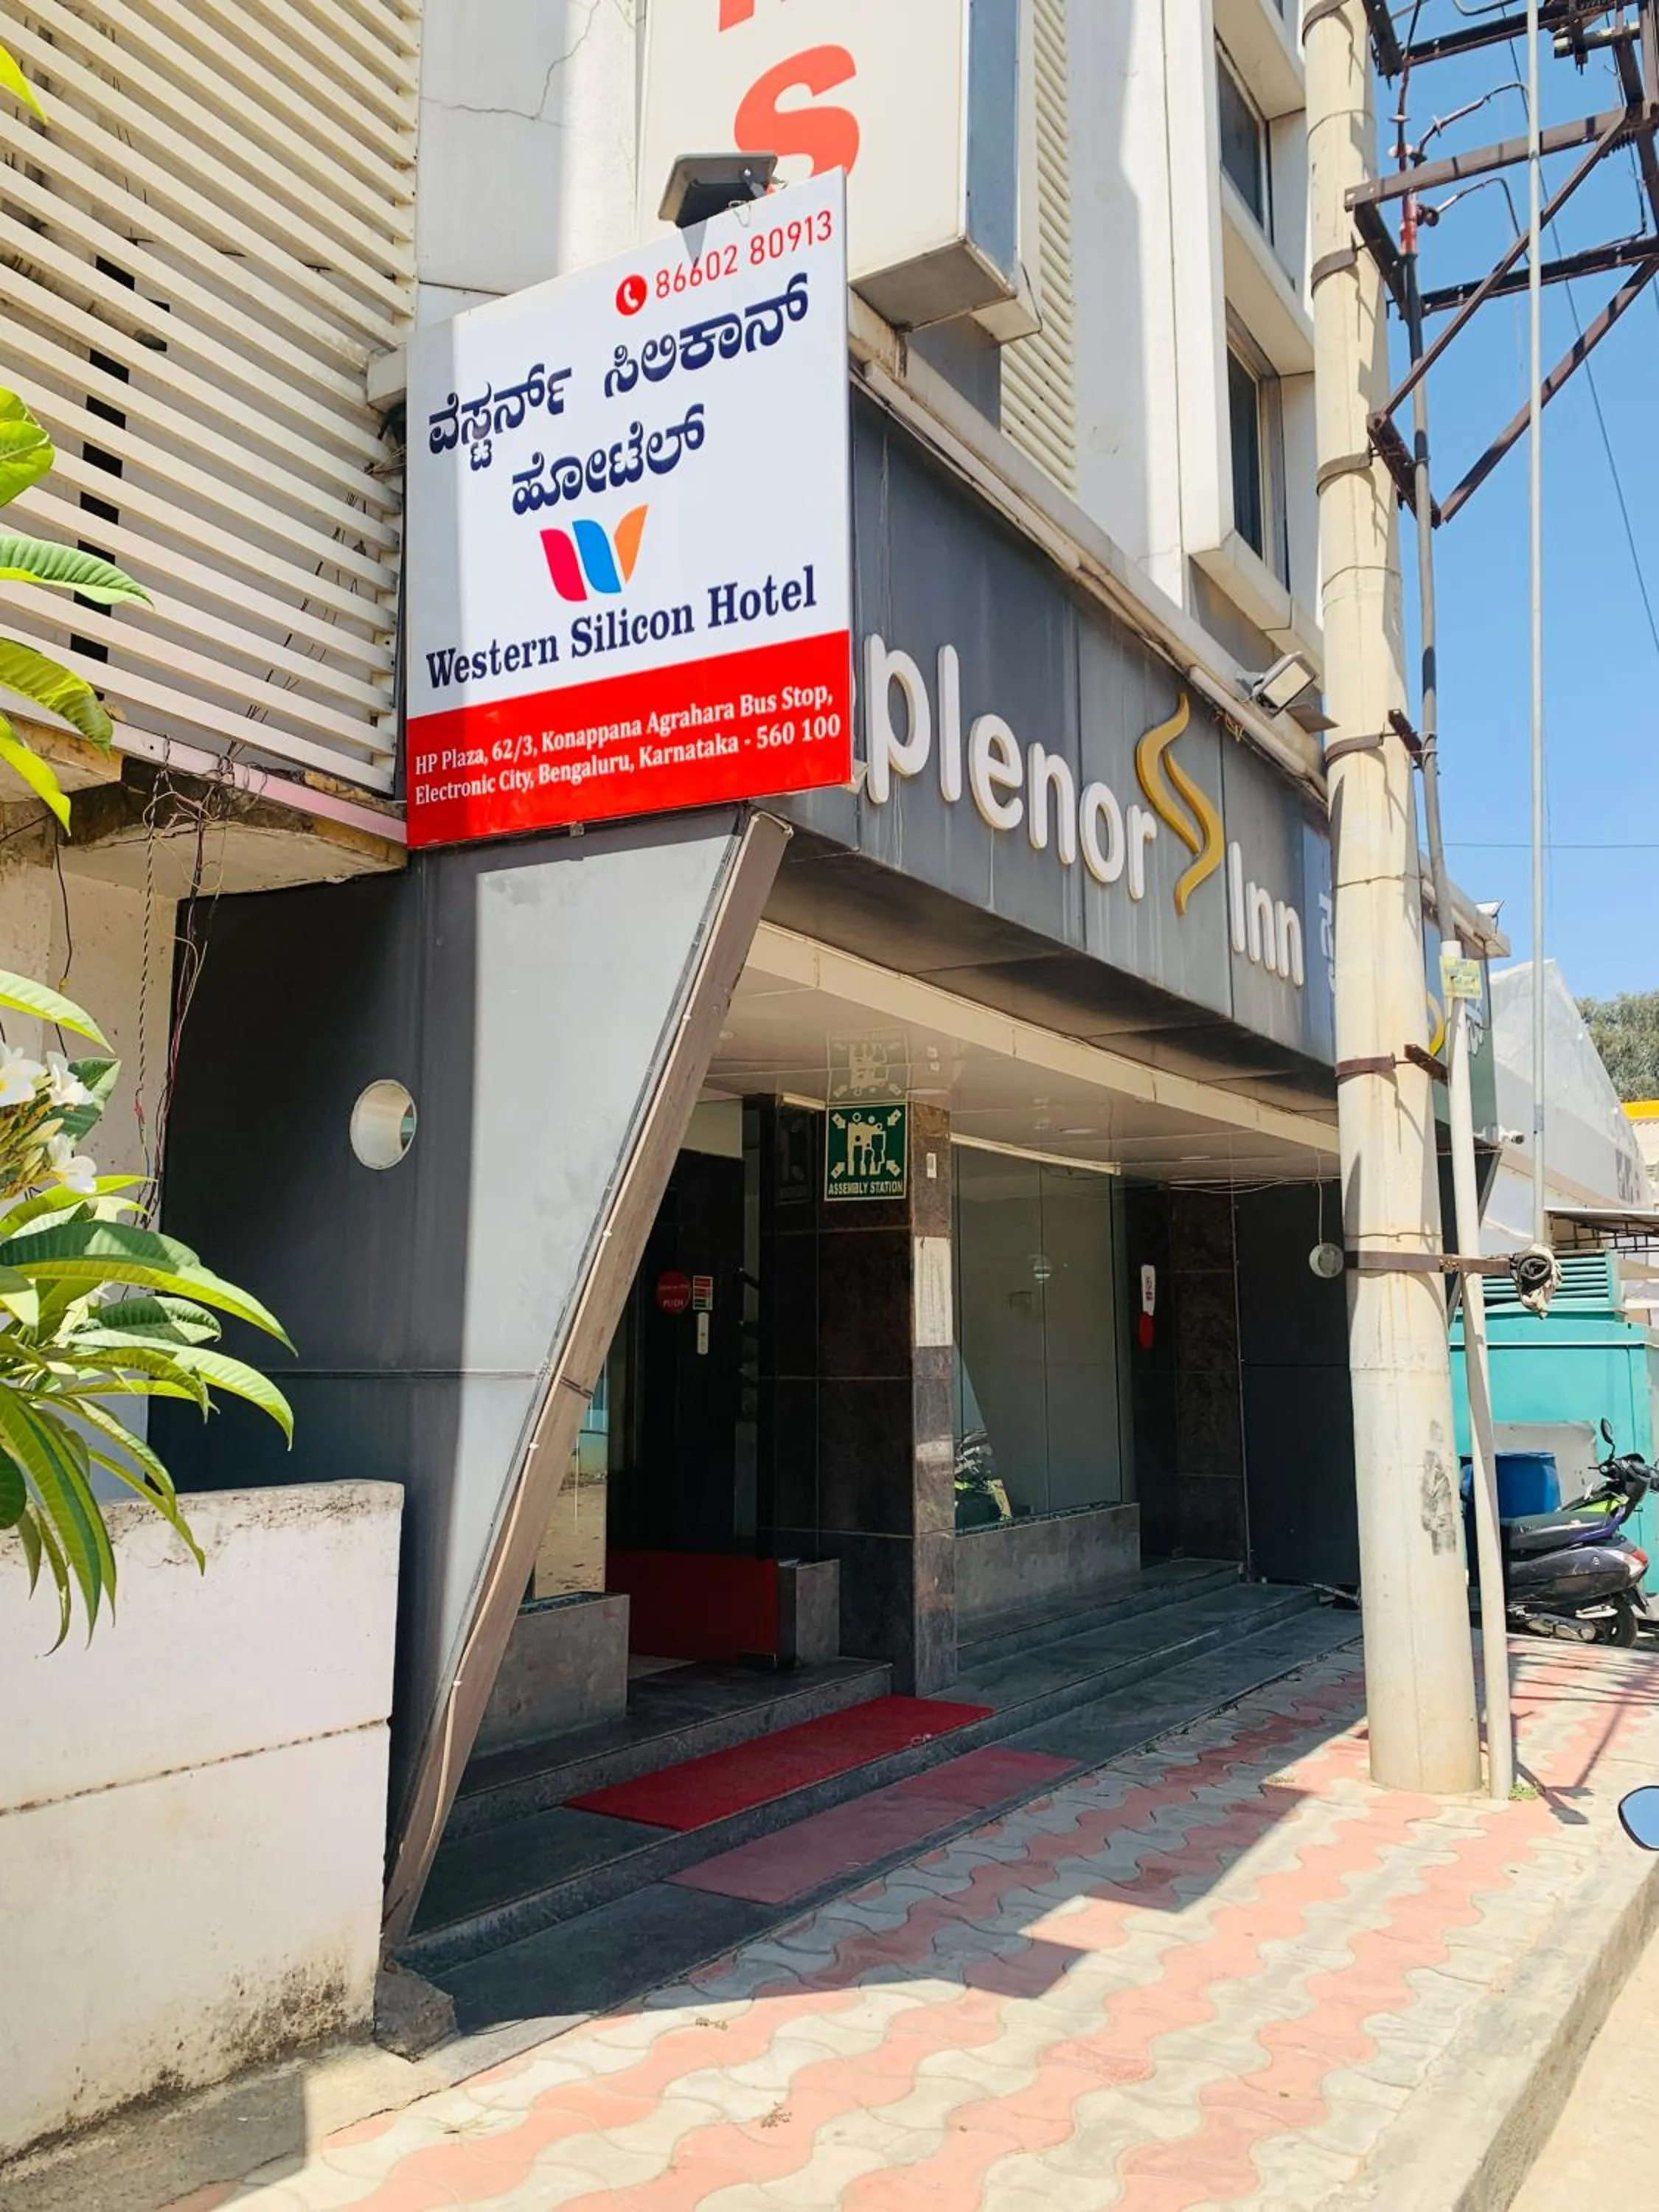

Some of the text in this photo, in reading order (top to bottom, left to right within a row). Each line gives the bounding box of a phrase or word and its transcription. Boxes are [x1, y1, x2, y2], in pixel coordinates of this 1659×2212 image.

[717, 0, 860, 194] S
[655, 210, 833, 299] 86602 80913
[428, 272, 808, 471] ವೆಸ್ಟರ್ನ್ ಸಿಲಿಕಾನ್
[512, 403, 705, 515] ಹೋಟೆಲ್
[425, 565, 816, 689] Western Silicon Hotel
[415, 686, 833, 775] HP Plaza, 62/3, Konappana Agrahara Bus Stop,
[415, 774, 495, 805] Electronic
[498, 769, 535, 793] City,
[538, 754, 635, 786] Bengaluru,
[639, 733, 740, 768] Karnataka
[757, 722, 795, 749] 560
[801, 714, 841, 742] 100
[851, 633, 1156, 901] plenor
[1227, 841, 1304, 987] Inn
[828, 1180, 903, 1195] ASSEMBLY STATION
